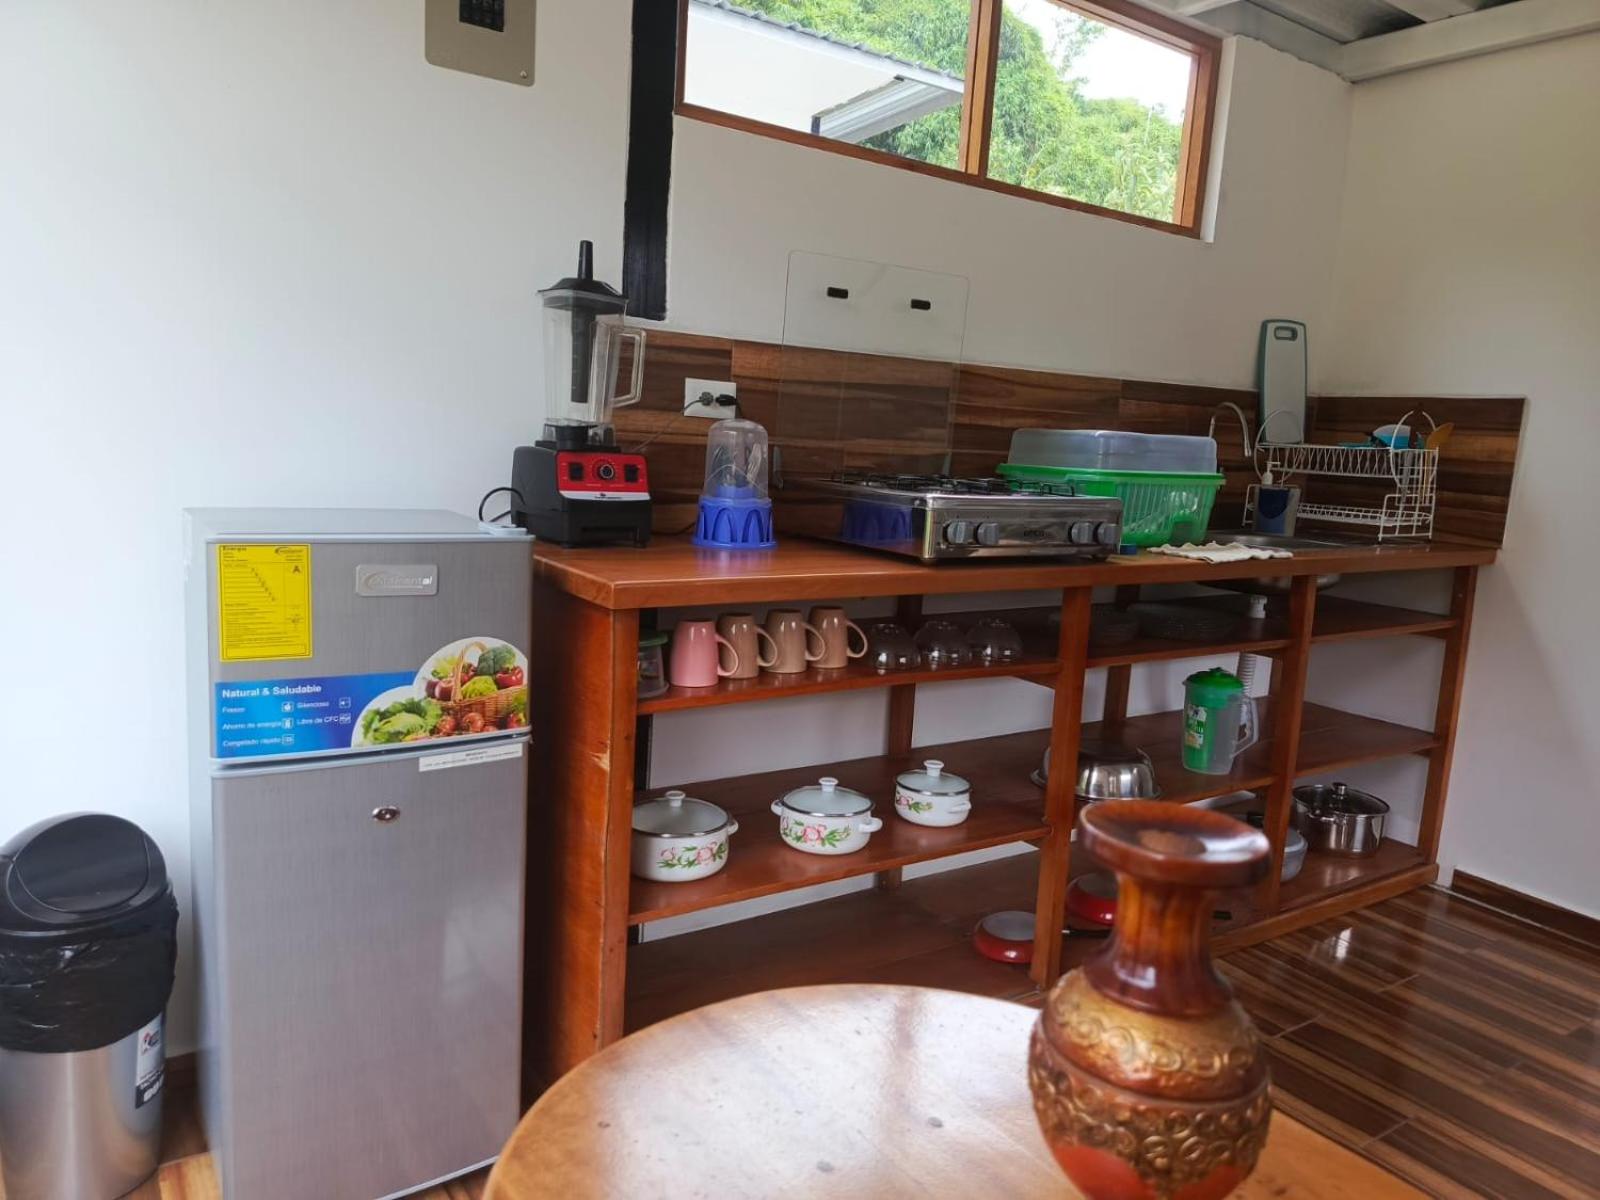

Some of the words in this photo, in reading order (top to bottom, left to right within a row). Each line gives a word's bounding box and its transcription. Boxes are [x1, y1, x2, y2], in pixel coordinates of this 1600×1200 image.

[222, 688, 260, 698] Natural
[262, 687, 270, 696] &
[272, 684, 322, 696] Saludable
